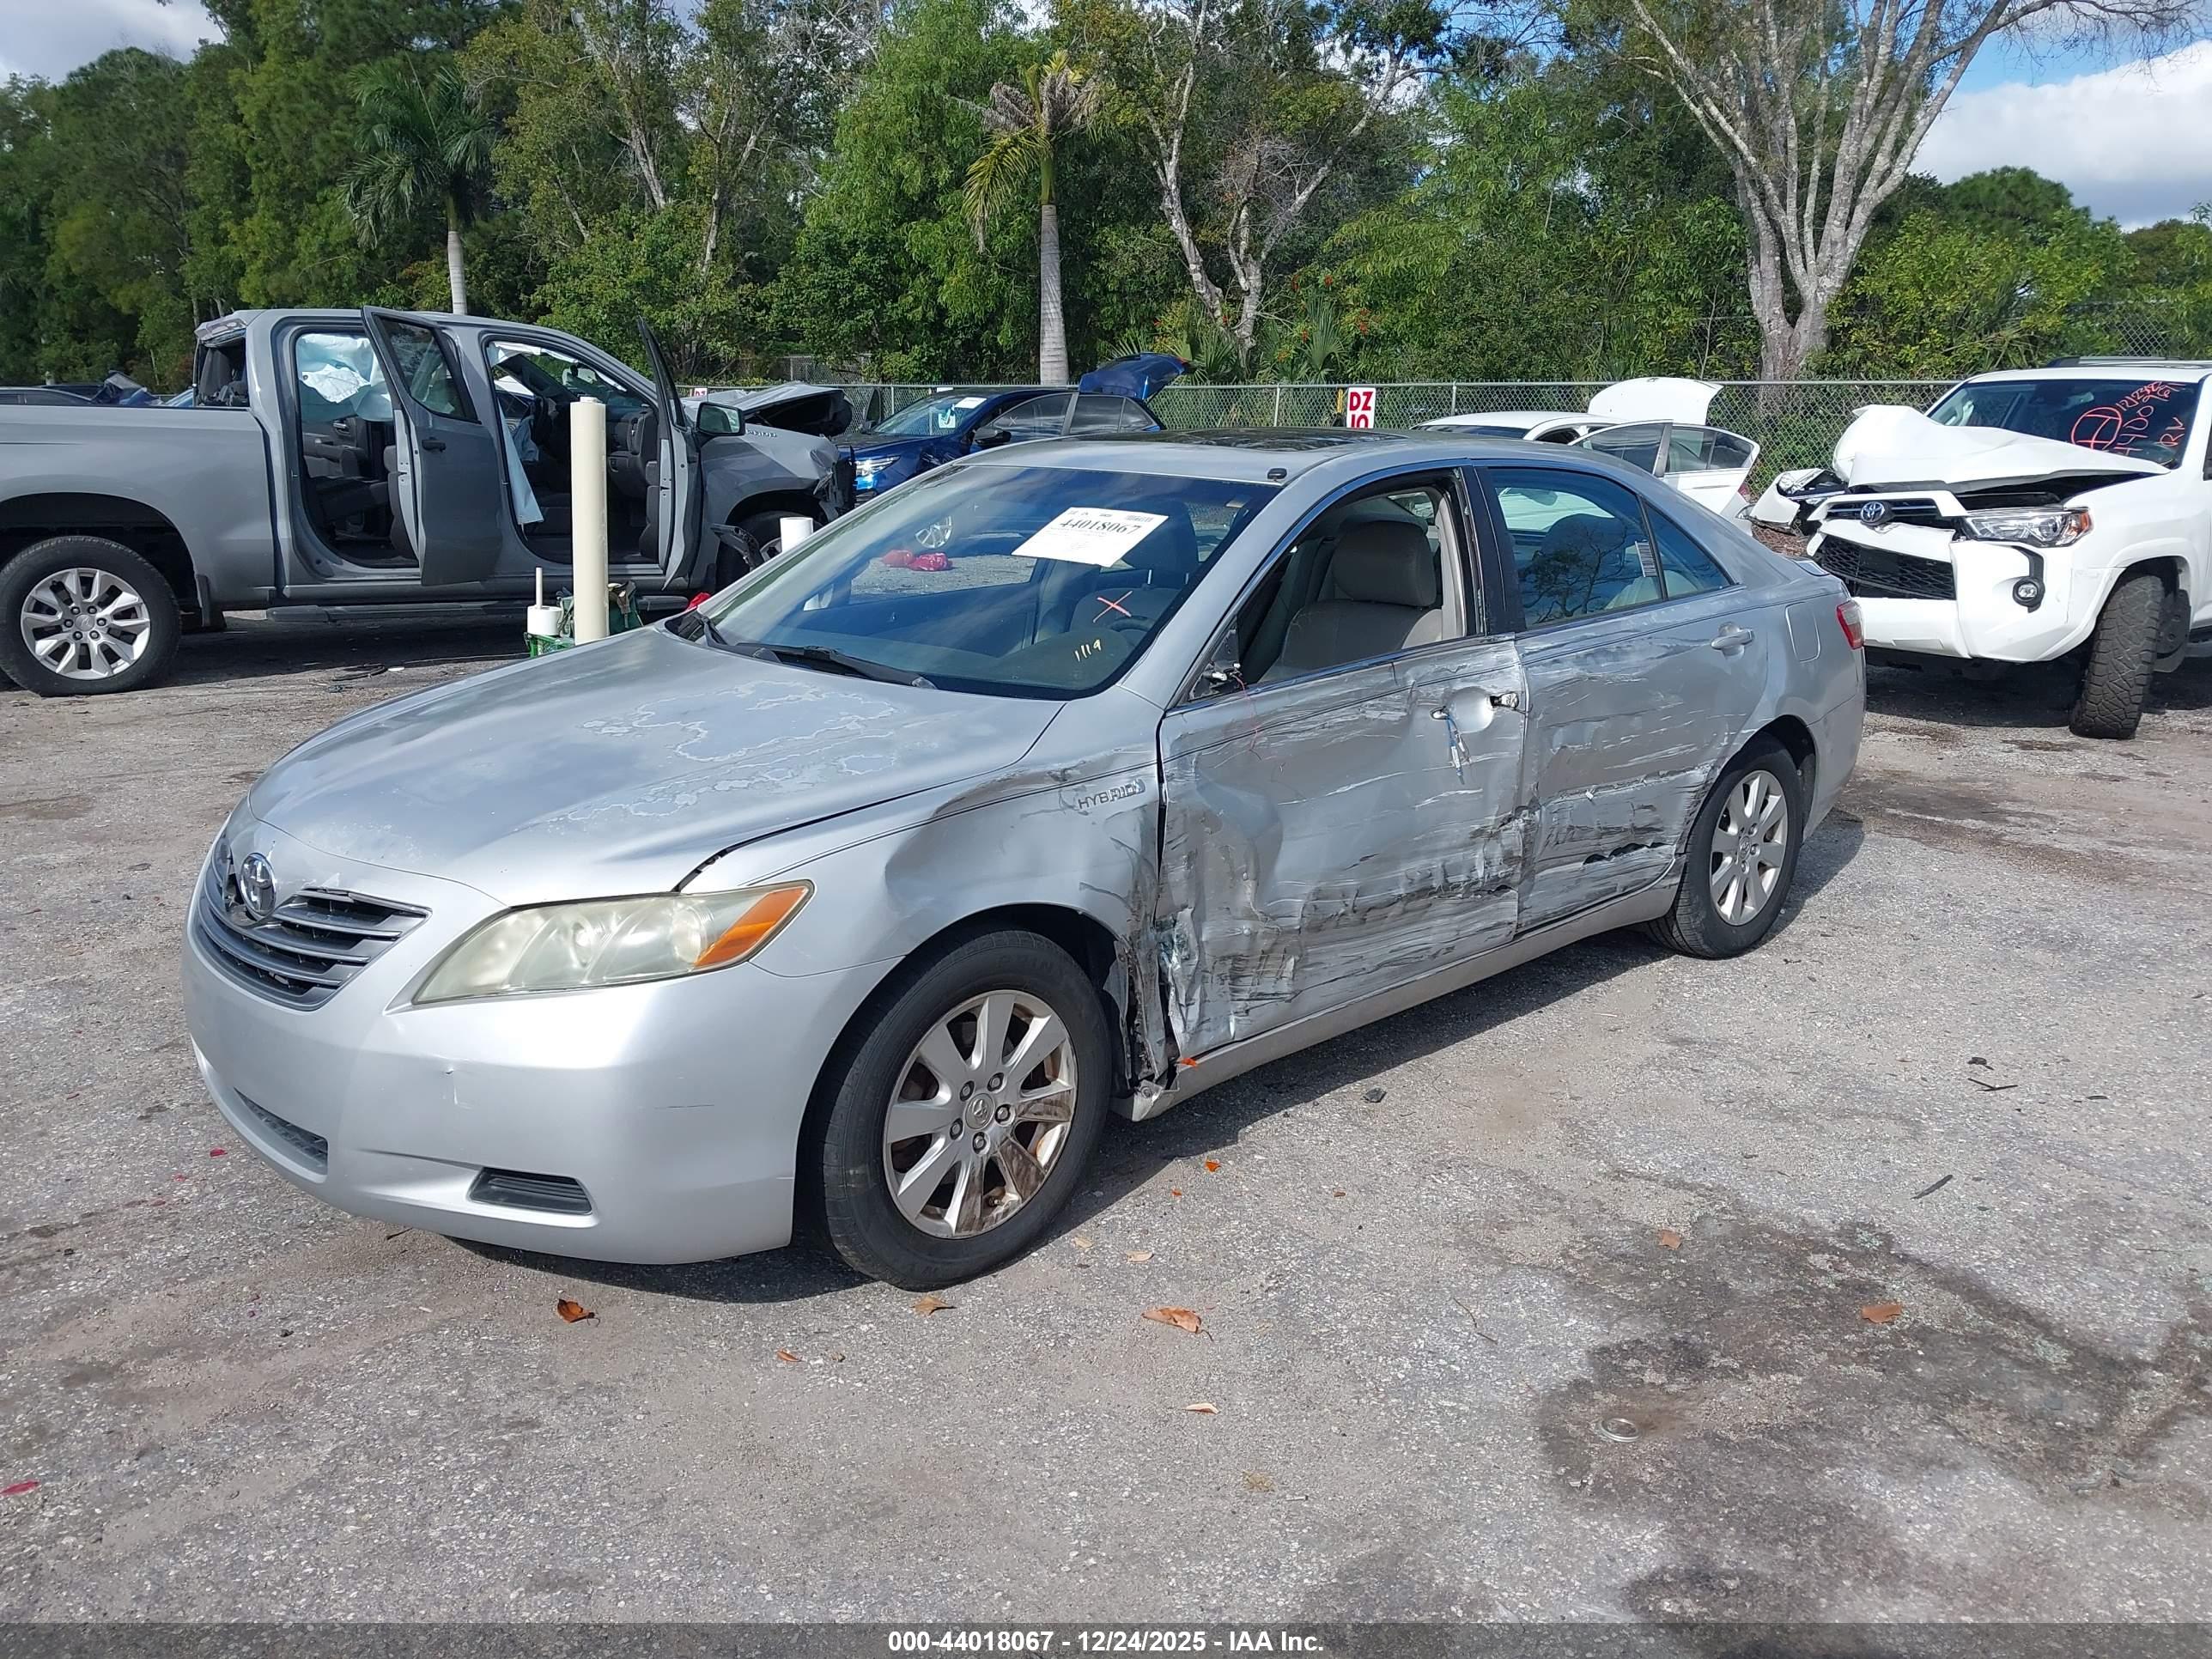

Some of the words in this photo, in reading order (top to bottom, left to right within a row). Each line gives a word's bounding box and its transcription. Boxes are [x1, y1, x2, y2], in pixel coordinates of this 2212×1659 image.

[1349, 391, 1373, 411] DZ
[1060, 519, 1141, 535] 44018067
[1078, 781, 1140, 809] HYBRID
